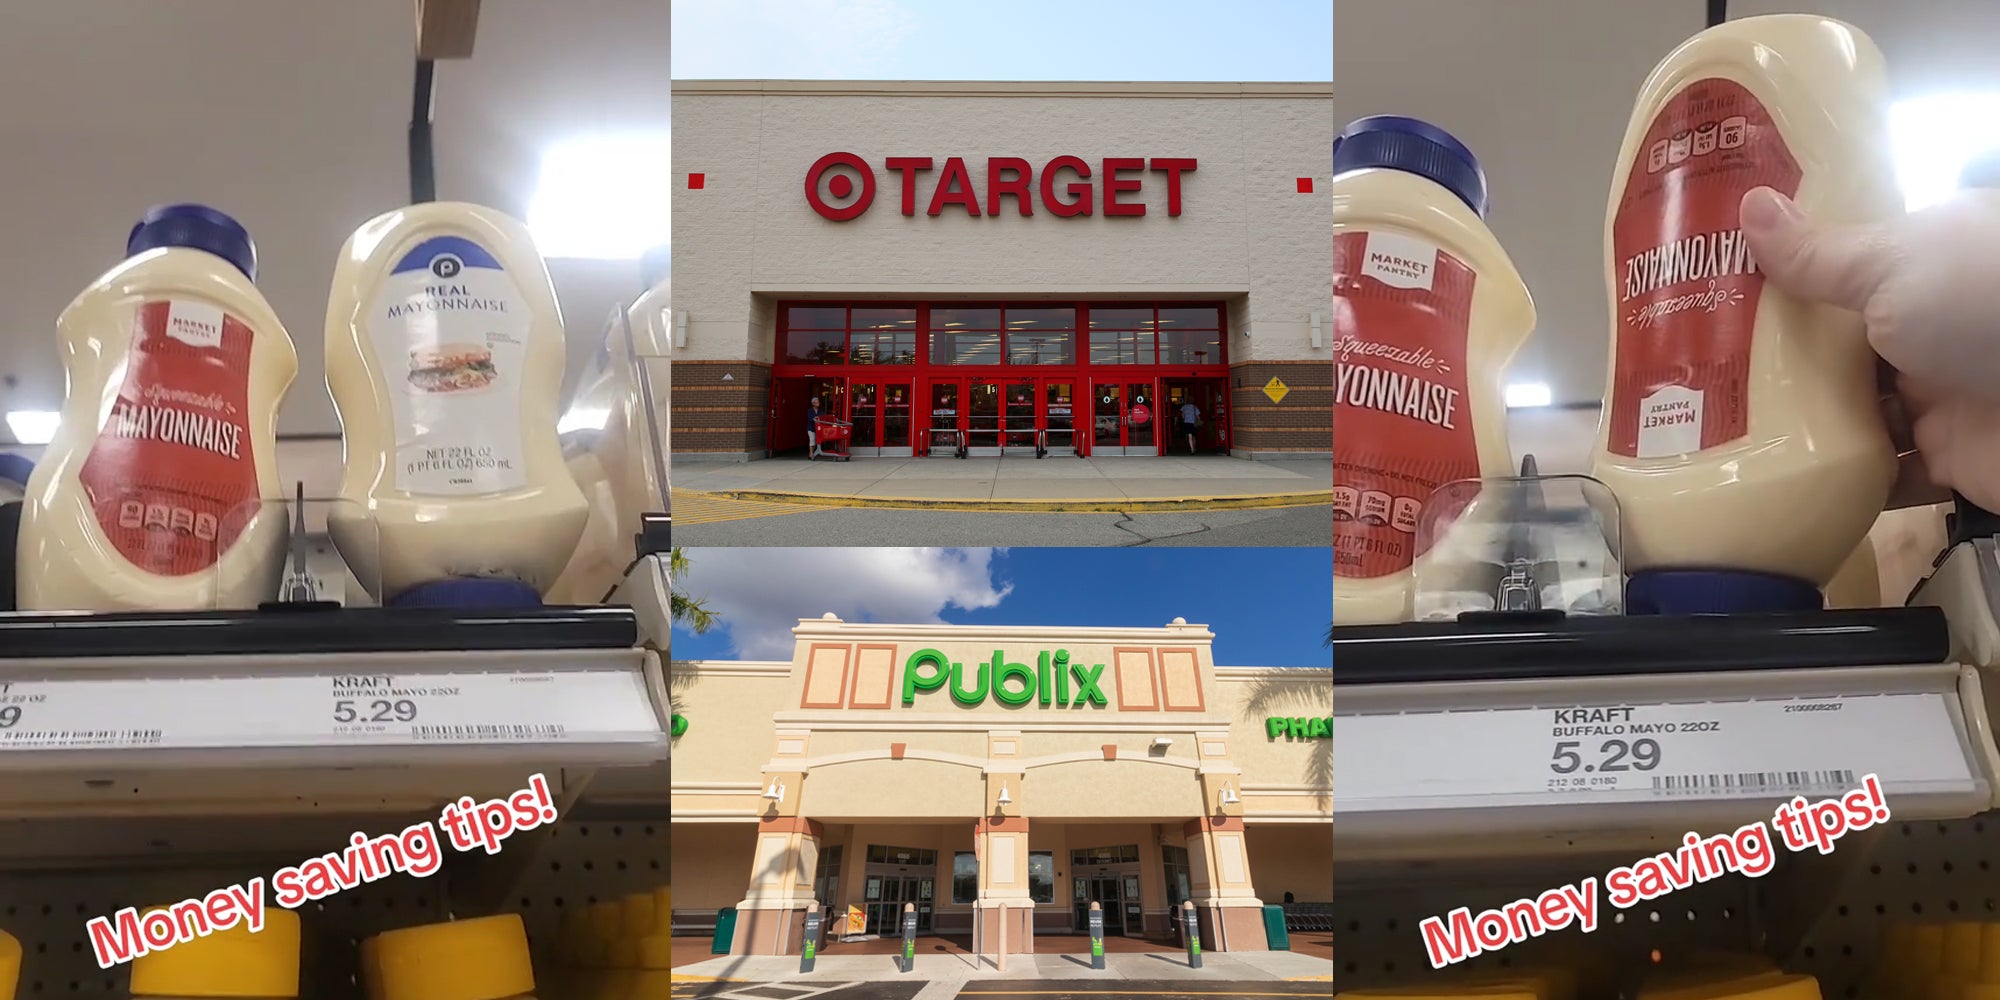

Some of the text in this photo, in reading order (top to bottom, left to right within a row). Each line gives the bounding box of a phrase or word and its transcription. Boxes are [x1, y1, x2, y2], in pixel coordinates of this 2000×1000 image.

[1726, 132, 1738, 144] 90
[885, 155, 1198, 217] TARGET
[1370, 252, 1429, 275] MARKET
[1377, 264, 1420, 280] PANTRY
[1622, 229, 1757, 302] MAYONNAISE
[425, 284, 471, 297] REAL
[387, 298, 509, 320] MAYONNAISE
[1637, 279, 1728, 330] Squeezable
[1333, 334, 1435, 369] Squeezable
[1333, 362, 1459, 430] YONNAISE
[1650, 400, 1690, 413] PANTRY
[1643, 409, 1696, 428] MARKET
[116, 402, 243, 460] MAYONNAISE
[426, 447, 444, 460] NET
[448, 446, 461, 458] 22
[464, 446, 475, 458] FL
[1375, 540, 1385, 554] FL
[332, 676, 394, 688] KRAFT
[901, 647, 1108, 707] Publix
[333, 688, 388, 698] BUFFALO
[392, 688, 427, 696] MAYO
[333, 699, 417, 723] 5.29
[1553, 707, 1635, 725] KRAFT
[1266, 716, 1333, 738] PHA
[1552, 721, 1721, 737] BUFFALO MAYO 22OZ
[1550, 738, 1662, 774] 5.29
